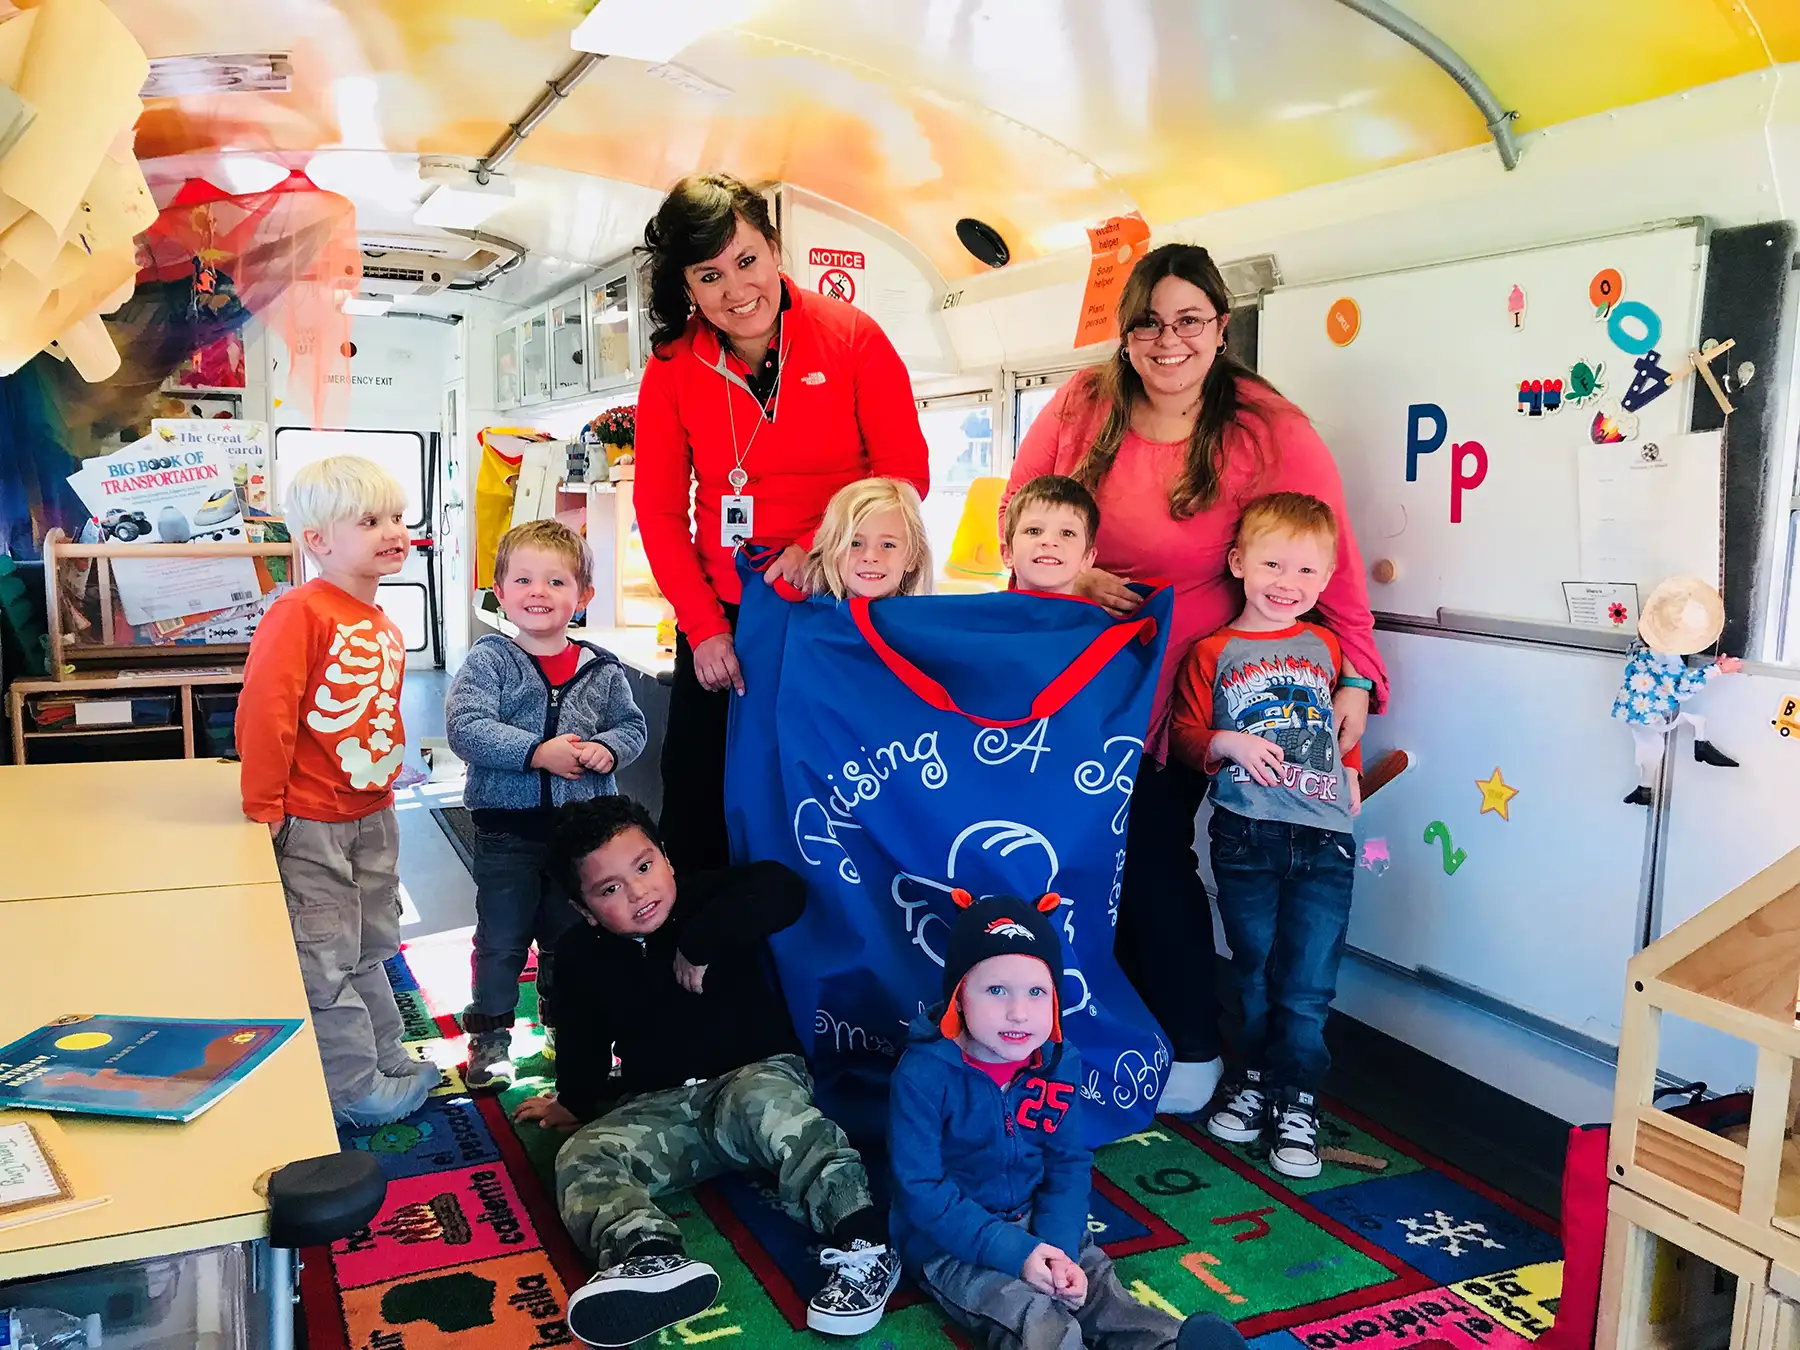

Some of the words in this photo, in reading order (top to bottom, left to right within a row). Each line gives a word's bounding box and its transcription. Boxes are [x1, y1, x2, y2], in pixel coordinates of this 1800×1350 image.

[1094, 223, 1120, 237] Weather
[1098, 237, 1120, 250] helper
[811, 251, 863, 268] NOTICE
[1096, 265, 1114, 277] Soap
[1093, 277, 1114, 290] helper
[943, 291, 964, 310] EXIT
[1087, 304, 1106, 315] Plant
[1084, 317, 1108, 330] person
[324, 375, 374, 385] EMERGENCY
[375, 377, 393, 386] EXIT
[180, 432, 203, 444] The
[206, 432, 242, 445] Great
[108, 463, 137, 478] BIG
[139, 453, 185, 473] BOOK
[184, 451, 205, 465] OF
[101, 463, 220, 496] TRANSPORTATION
[1783, 700, 1796, 716] B
[1228, 761, 1338, 801] TUCK
[794, 730, 949, 884] Raising
[1423, 820, 1468, 876] 2
[1016, 1077, 1074, 1134] 25
[467, 1170, 526, 1245] caliente
[508, 1272, 562, 1320] silla
